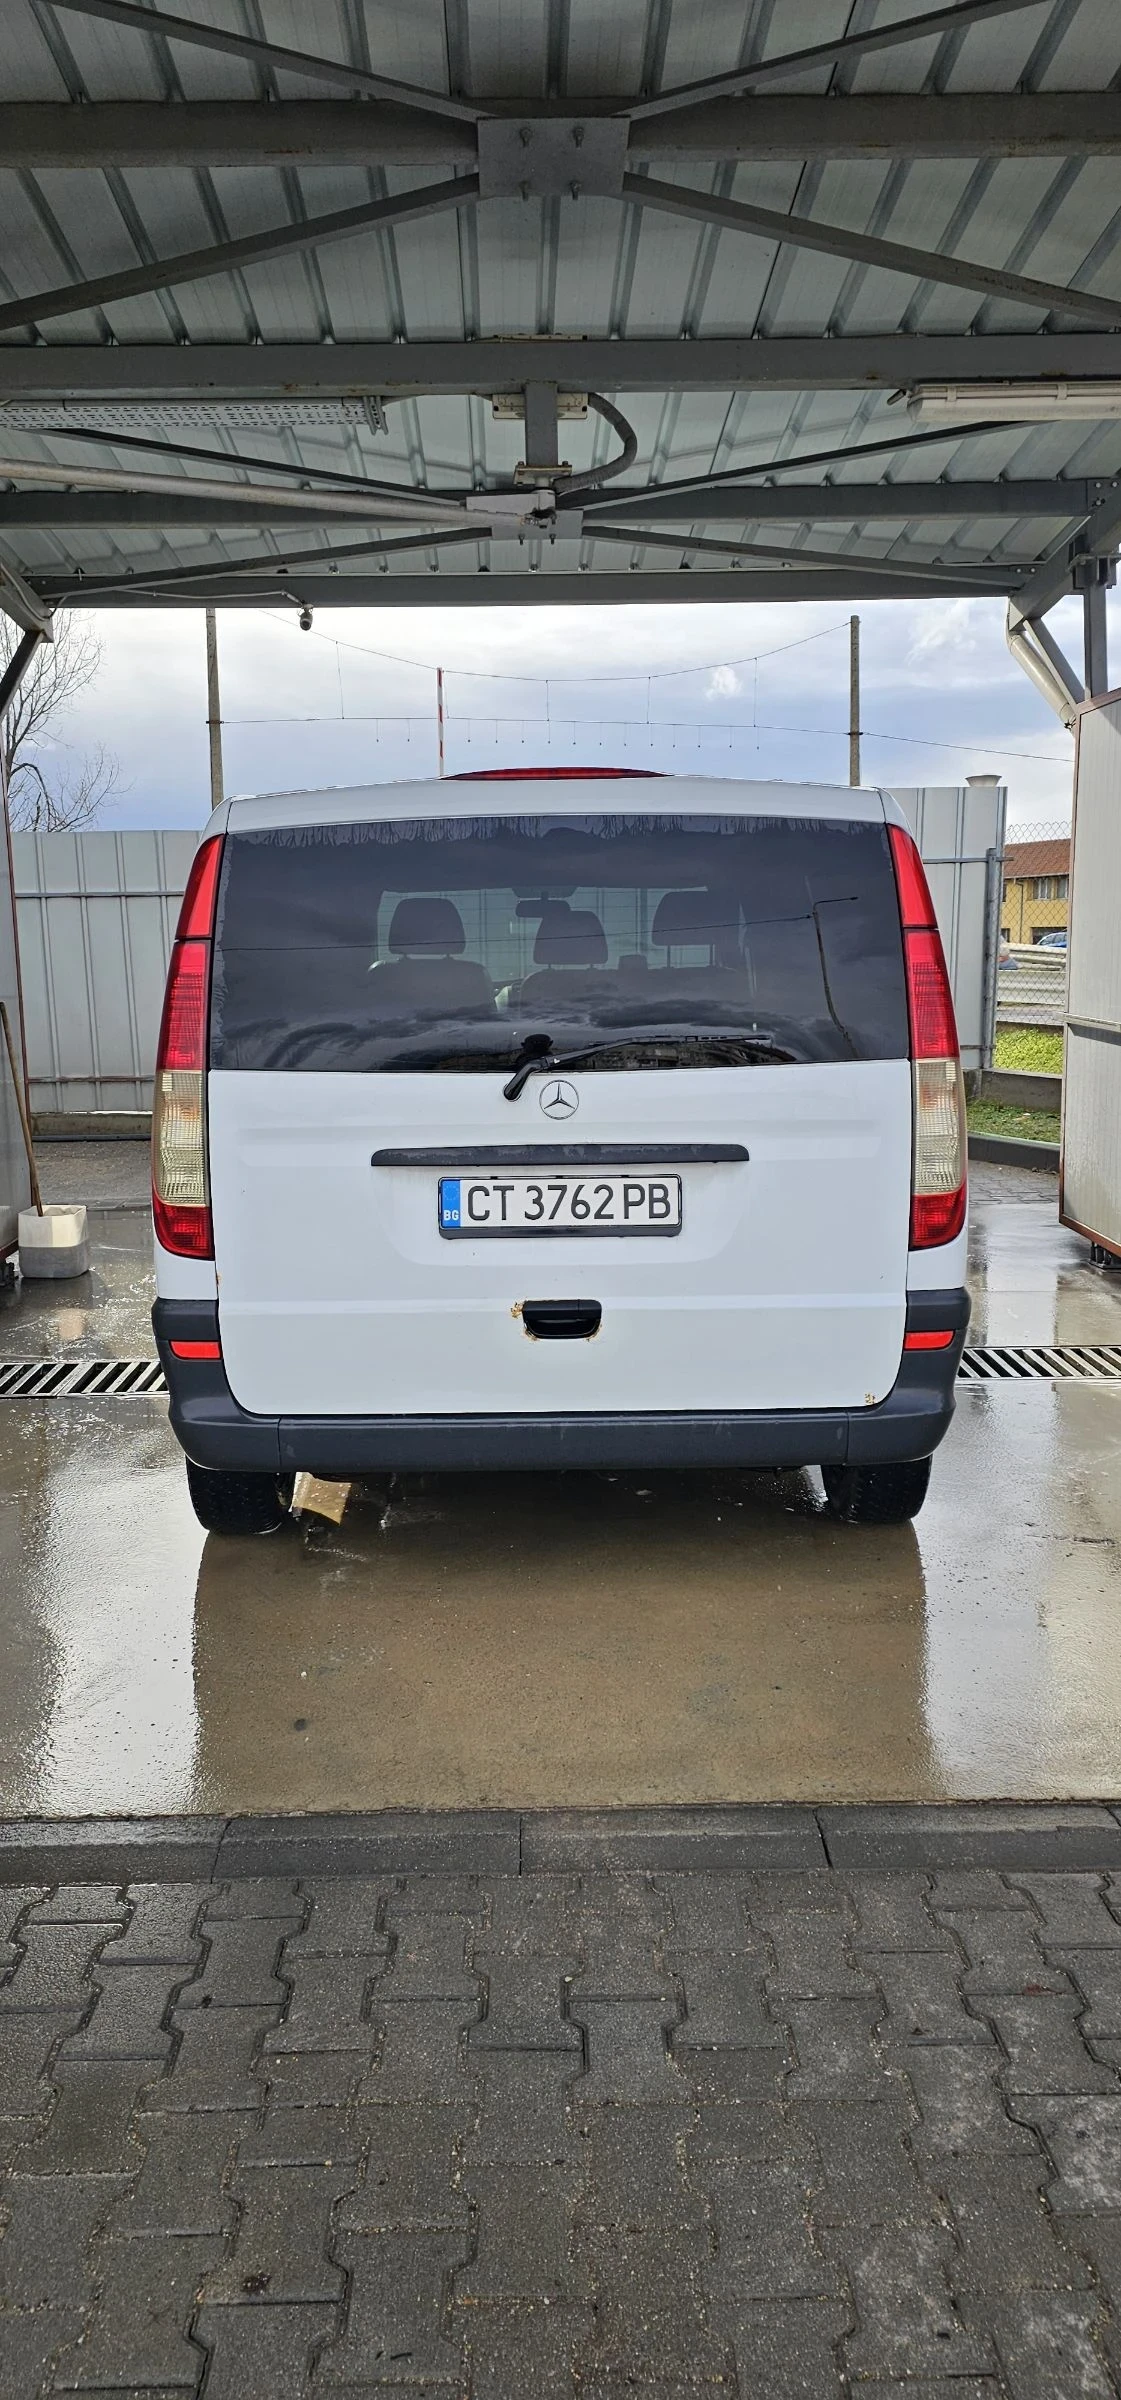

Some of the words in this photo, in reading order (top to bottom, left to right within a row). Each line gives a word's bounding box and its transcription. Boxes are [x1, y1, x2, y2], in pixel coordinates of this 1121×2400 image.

[467, 1185, 515, 1221] CT
[524, 1184, 615, 1220] 3762
[623, 1183, 671, 1220] PB
[443, 1209, 459, 1221] BG
